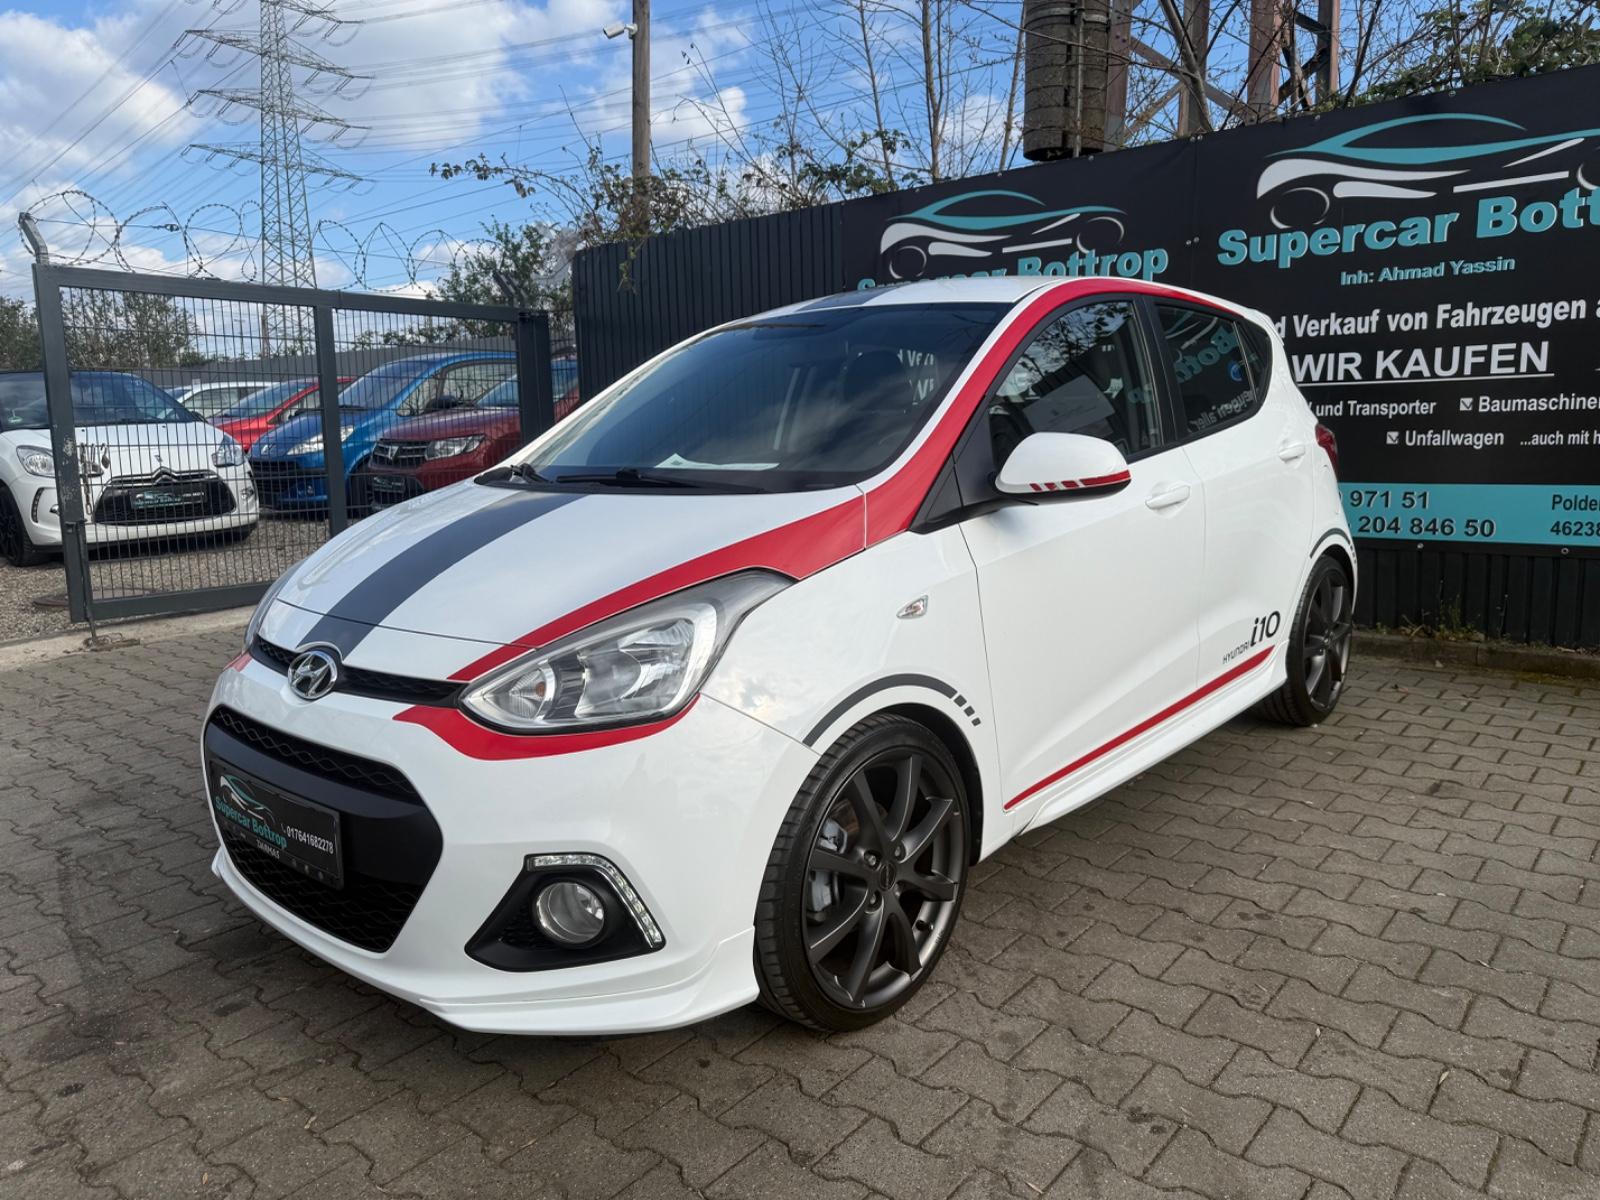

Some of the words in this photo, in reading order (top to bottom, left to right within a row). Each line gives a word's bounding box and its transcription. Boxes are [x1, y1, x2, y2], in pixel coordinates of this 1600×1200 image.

[1217, 212, 1460, 268] Supercar
[1341, 270, 1374, 285] Inh:
[1379, 262, 1445, 282] Ahmad
[1450, 256, 1515, 276] Yassin
[1293, 308, 1380, 338] Verkauf
[1387, 311, 1428, 332] von
[1436, 299, 1586, 328] Fahrzeugen
[1292, 352, 1362, 382] WIR
[1375, 341, 1549, 379] KAUFEN
[1315, 401, 1343, 417] und
[1348, 400, 1437, 419] Transporter
[1478, 392, 1600, 412] Baumaschine
[1405, 430, 1504, 450] Unfallwagen
[1568, 429, 1590, 445] mit
[1350, 489, 1391, 508] 971
[1401, 491, 1429, 509] 51
[1551, 494, 1600, 511] Polde
[1358, 515, 1401, 534] 204
[1409, 517, 1455, 536] 846
[1464, 519, 1496, 538] 50
[1250, 610, 1281, 647] i10
[252, 817, 287, 849] Bottrop
